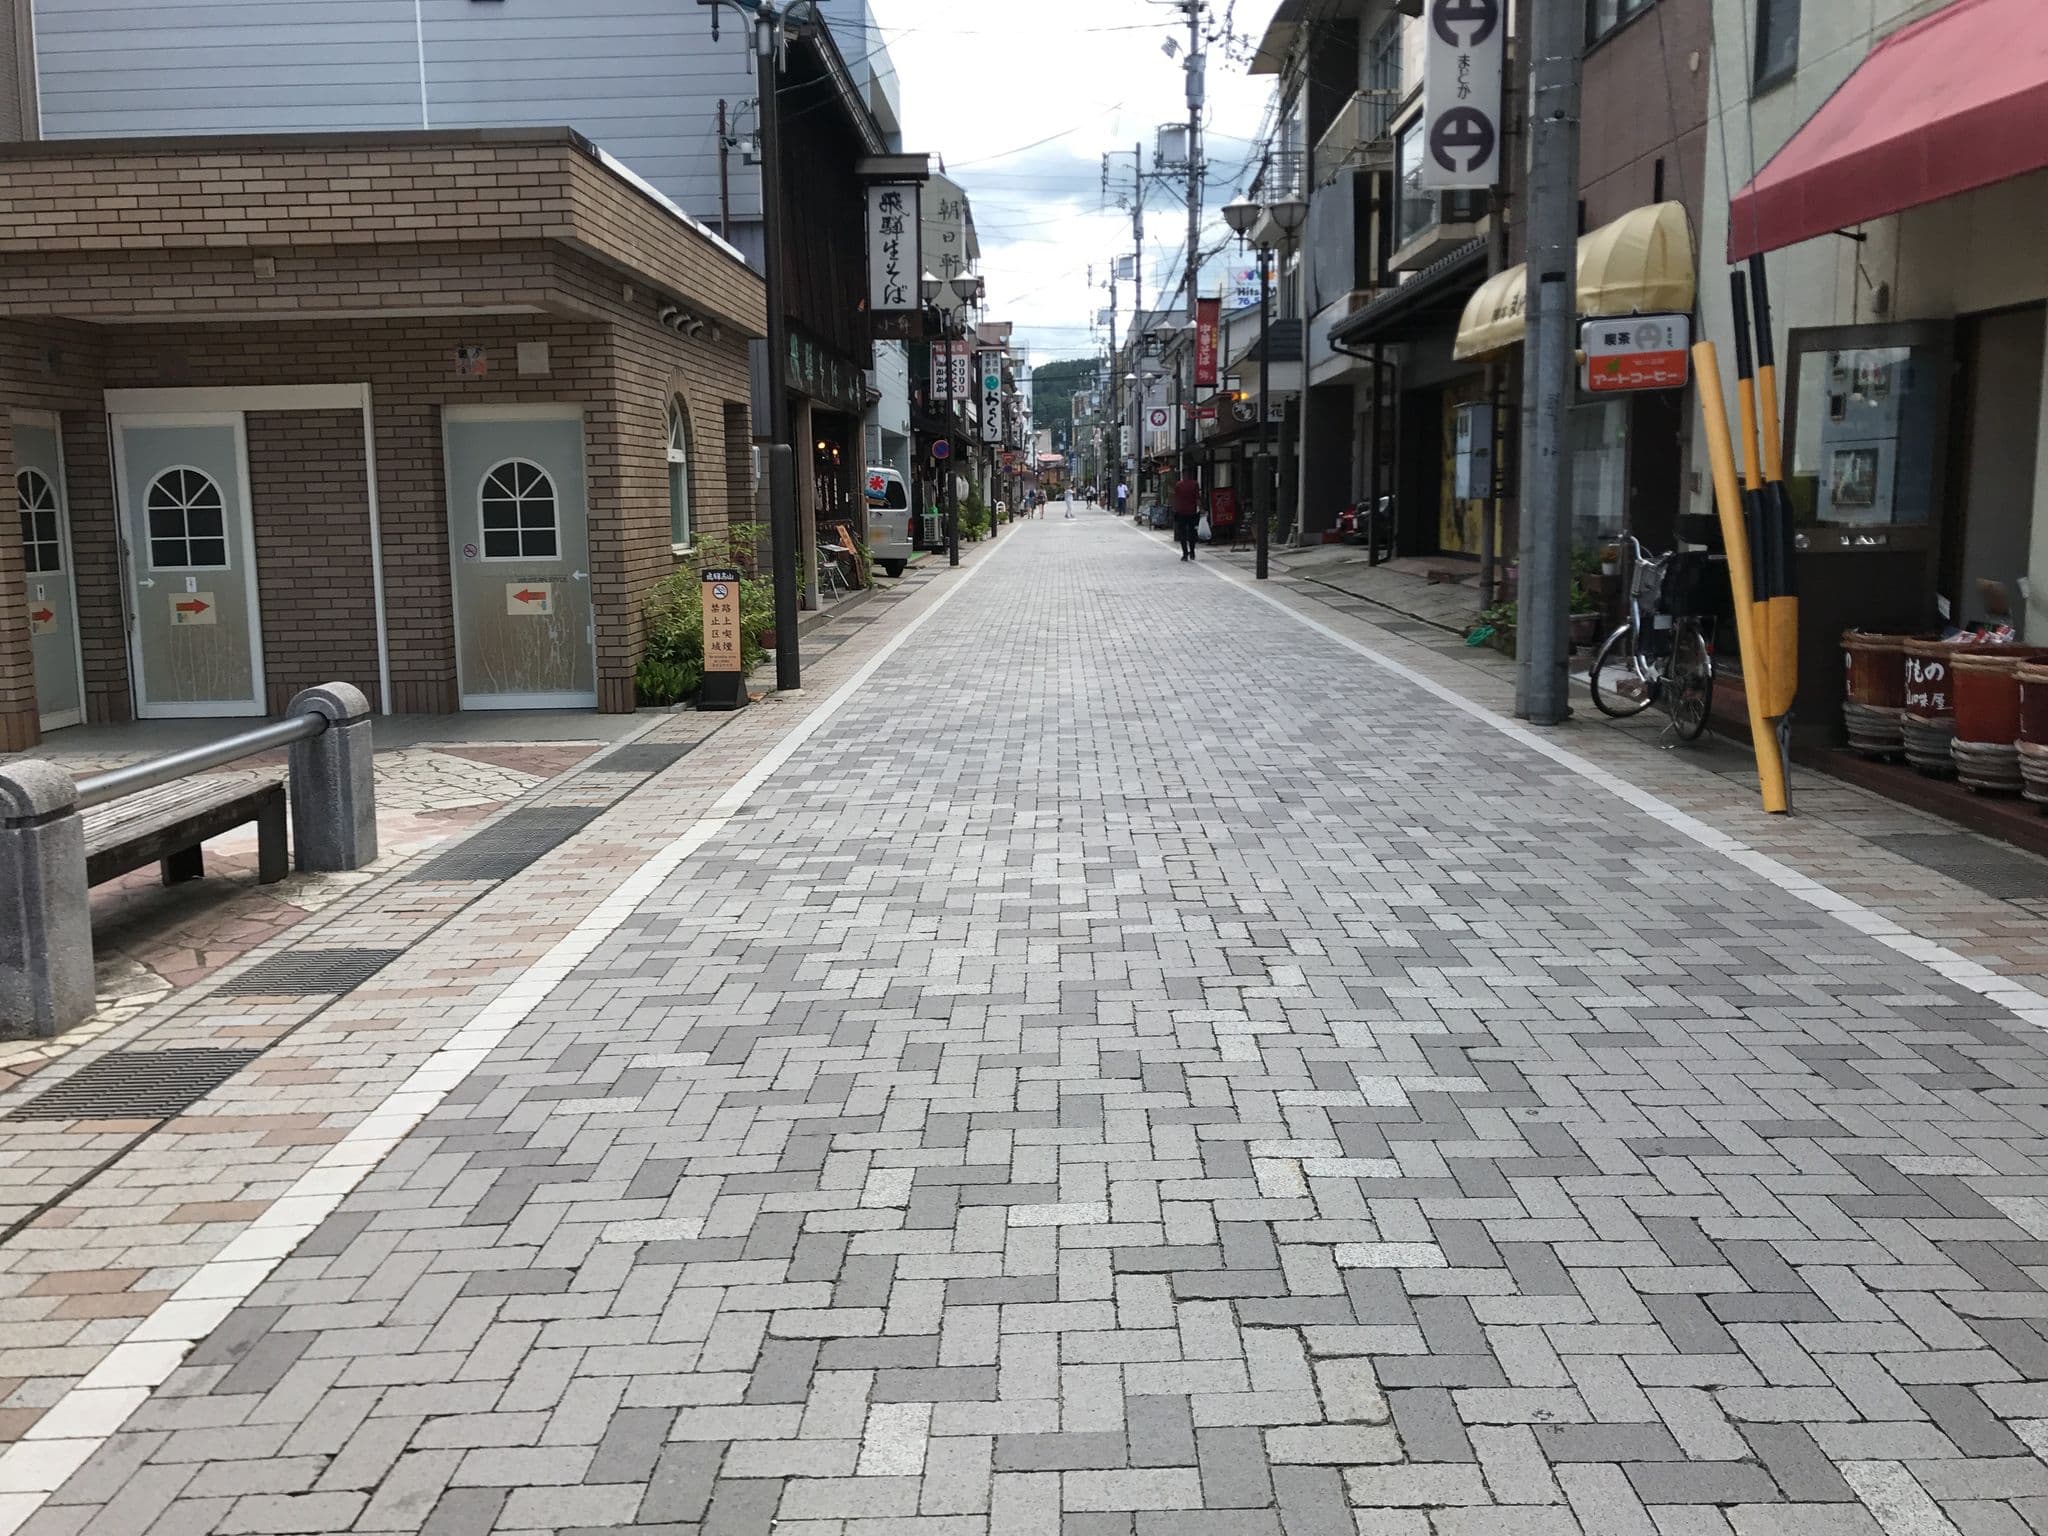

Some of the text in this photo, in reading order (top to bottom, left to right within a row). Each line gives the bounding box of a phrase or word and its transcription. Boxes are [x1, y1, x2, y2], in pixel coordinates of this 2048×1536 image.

[1457, 54, 1471, 100] まどか
[879, 191, 910, 305] 飛騨生そば
[938, 196, 961, 281] 朝日軒
[1199, 323, 1212, 366] 中華そば
[1604, 331, 1632, 346] 喫茶
[1593, 370, 1678, 386] アートコーヒー
[710, 603, 721, 652] 禁止区域
[721, 603, 733, 652] 路上喫煙
